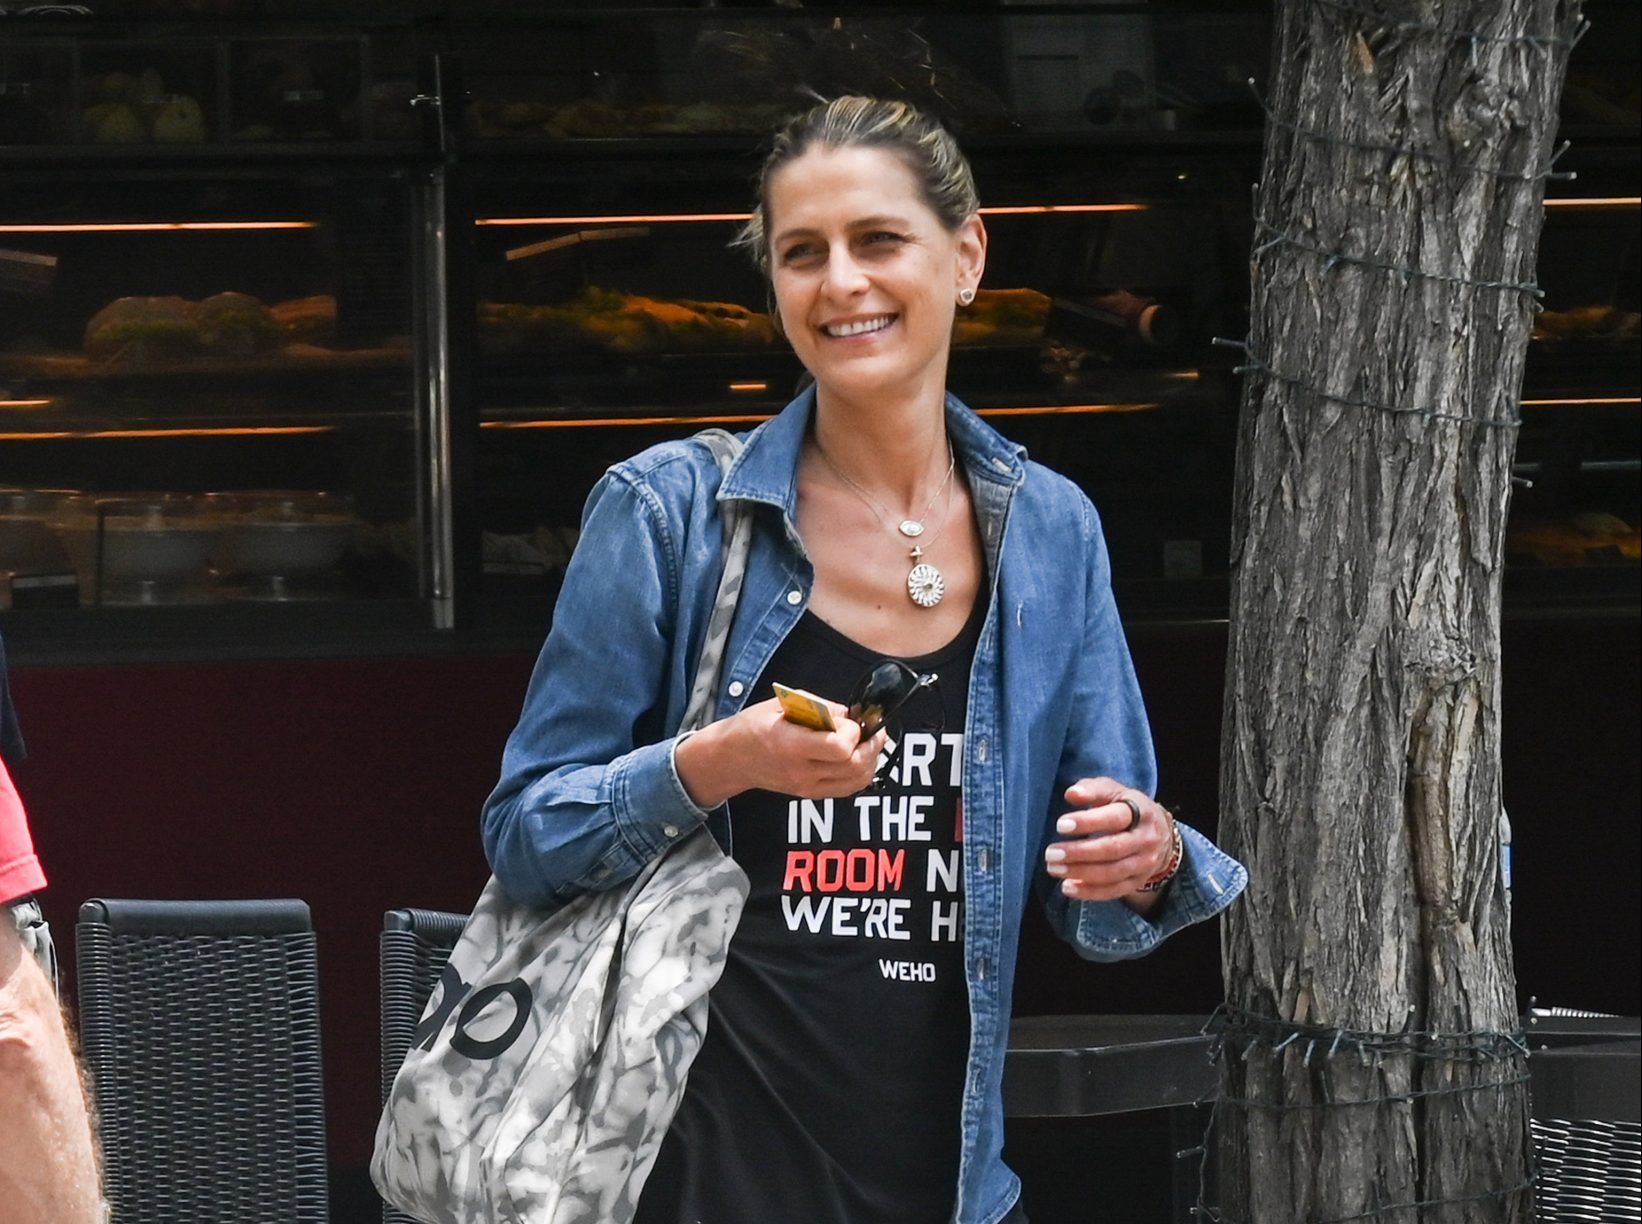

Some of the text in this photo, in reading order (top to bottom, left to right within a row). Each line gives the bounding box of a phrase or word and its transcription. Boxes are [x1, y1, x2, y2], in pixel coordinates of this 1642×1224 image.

[788, 798, 834, 843] IN
[854, 796, 934, 841] THE
[783, 848, 905, 892] ROOM
[781, 895, 911, 940] WE'RE
[879, 959, 936, 982] WEHO
